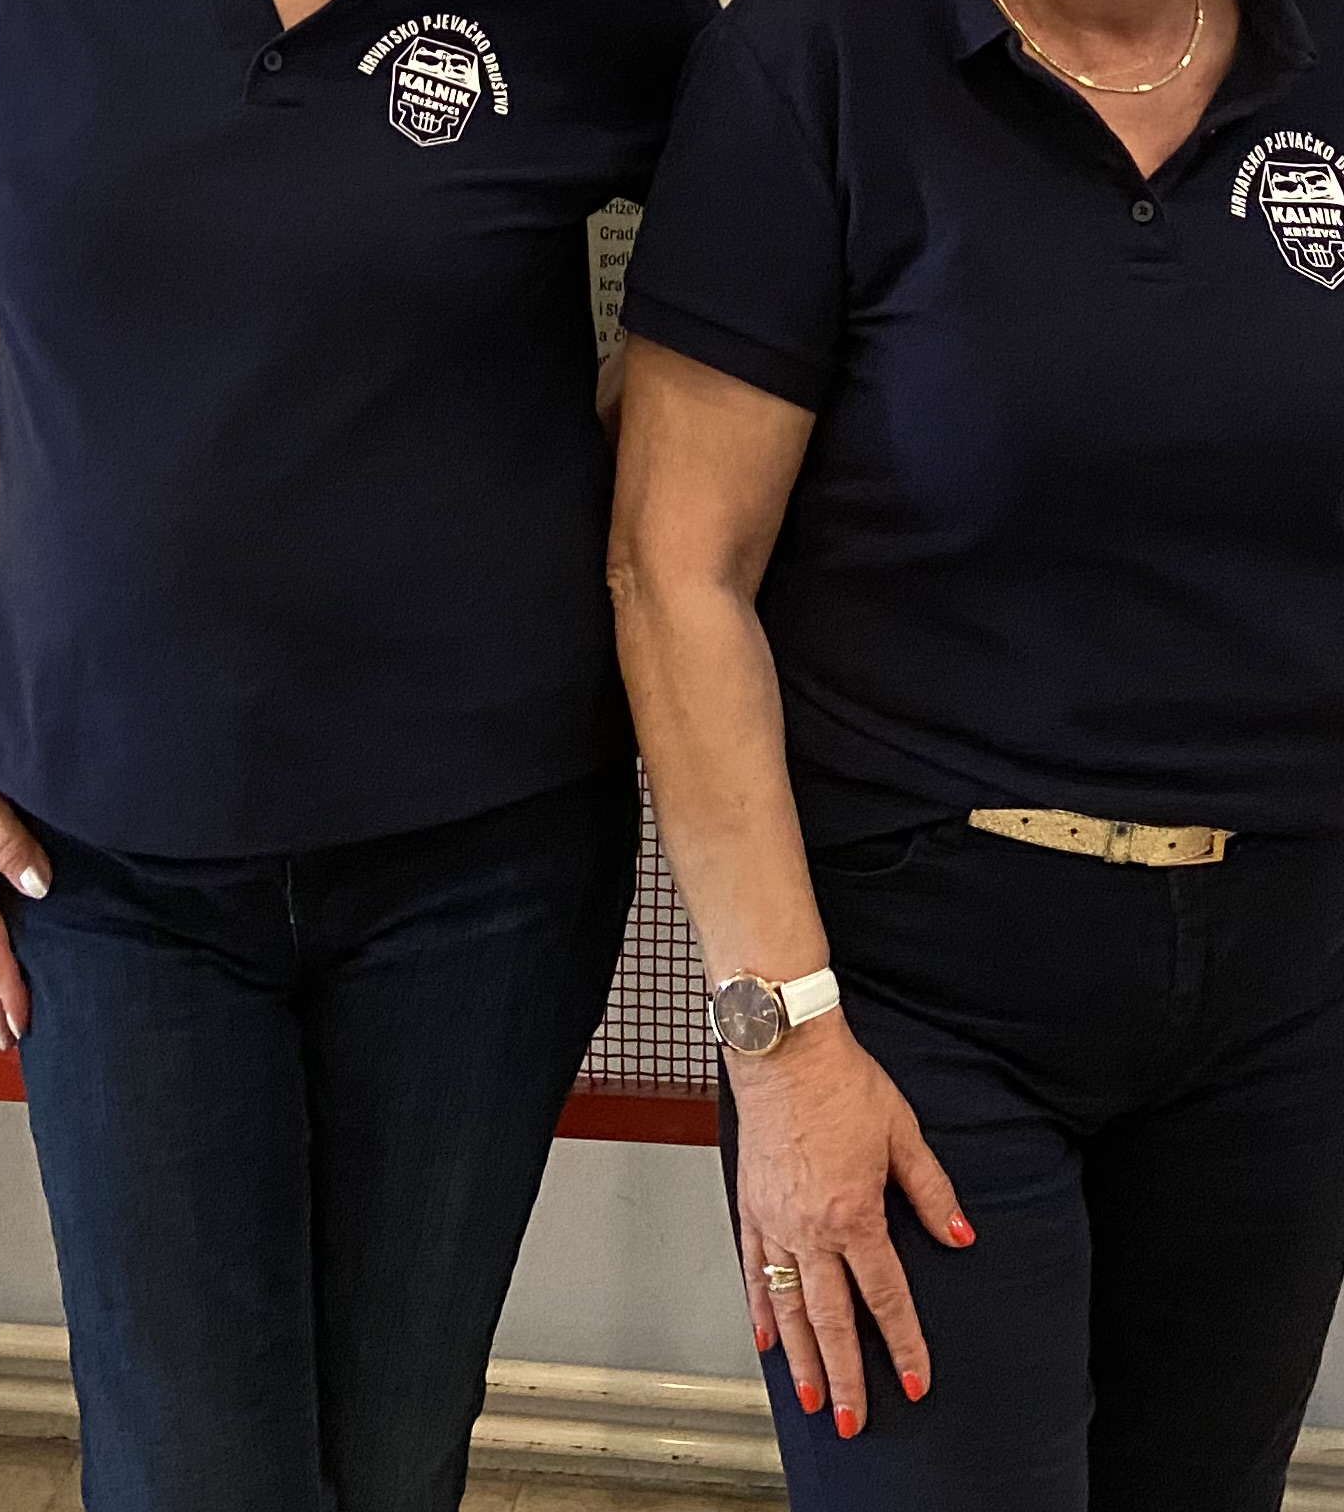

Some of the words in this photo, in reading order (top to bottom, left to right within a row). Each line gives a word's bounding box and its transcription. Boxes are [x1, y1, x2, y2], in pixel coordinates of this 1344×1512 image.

[358, 20, 419, 76] HRVATSKO
[422, 14, 490, 52] PJEVAČKO
[483, 53, 509, 116] DRUŠTVO
[398, 71, 471, 107] KALNIK
[402, 91, 460, 116] KRIŽEVCI
[1230, 144, 1267, 219] HRVATSKO
[1264, 131, 1335, 161] PJEVAČKO
[1271, 205, 1344, 227] KALNIK
[1283, 226, 1340, 239] KRIŽEVCI
